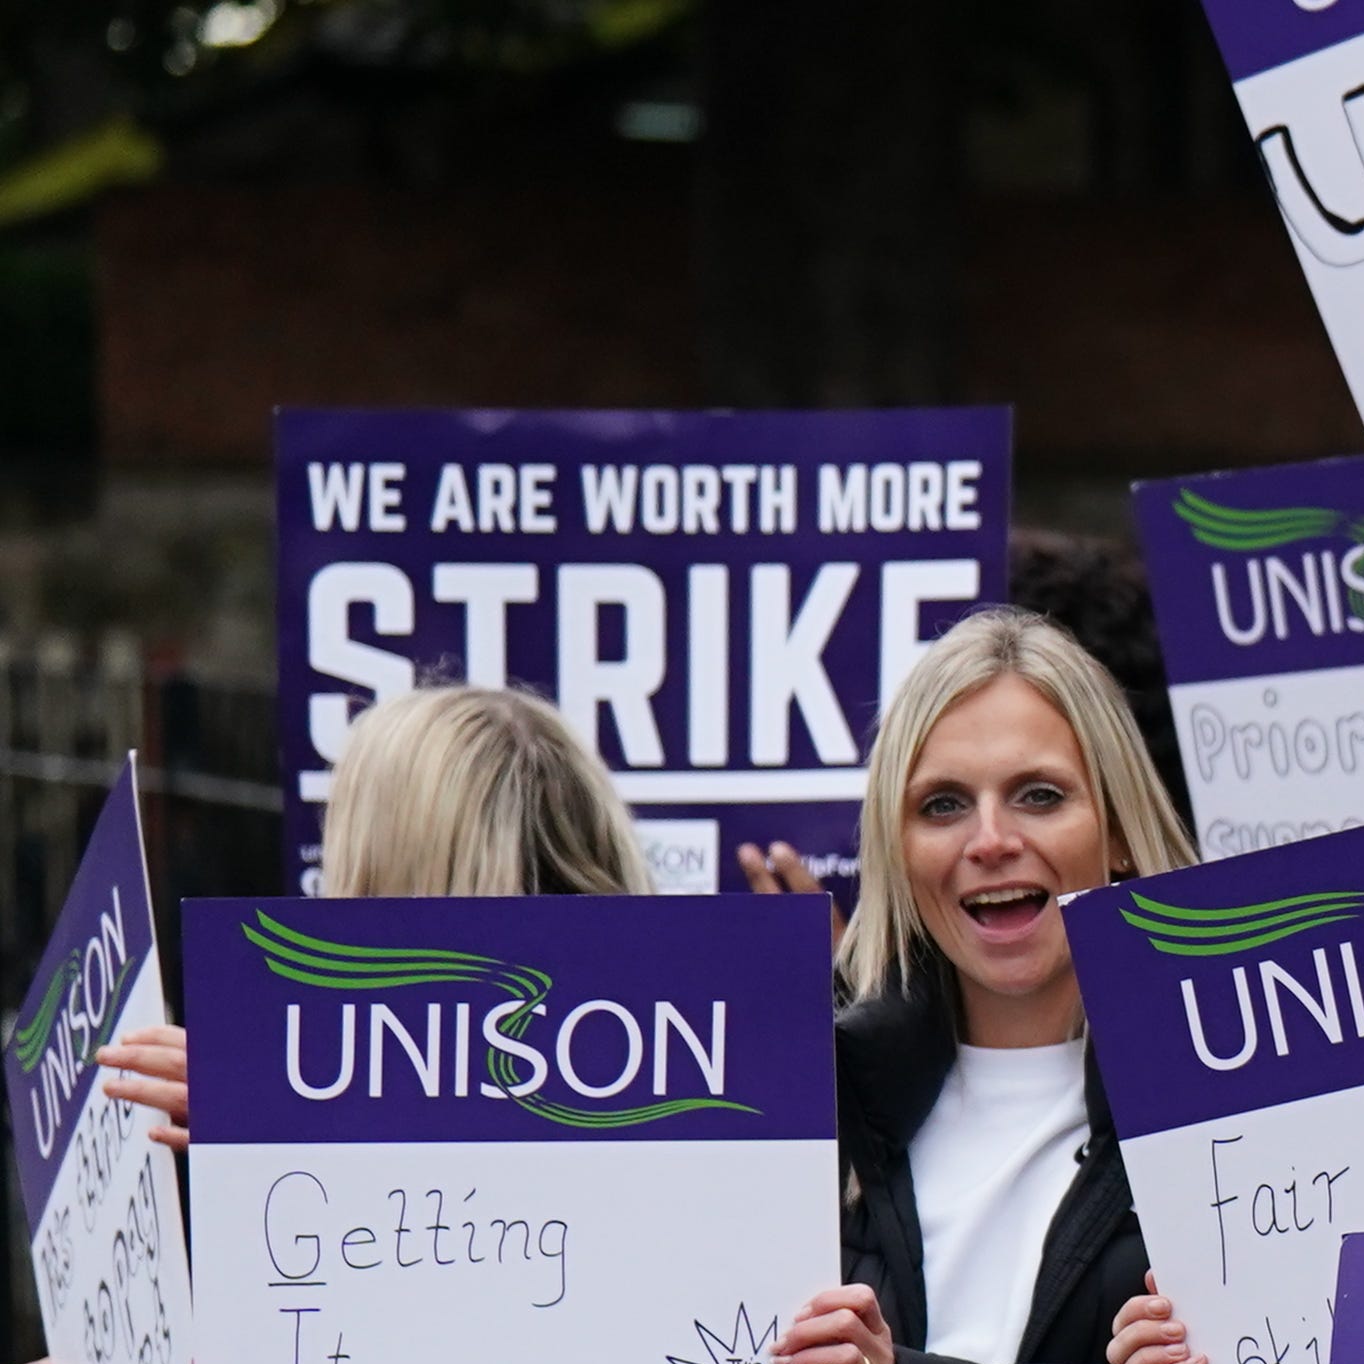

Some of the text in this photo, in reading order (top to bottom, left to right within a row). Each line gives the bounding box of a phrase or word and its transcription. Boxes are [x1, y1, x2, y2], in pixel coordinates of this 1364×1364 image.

[306, 460, 983, 535] WE ARE WORTH MORE
[30, 884, 127, 1161] UNISON
[285, 999, 727, 1101] UNISON
[264, 1170, 569, 1307] Getting
[1210, 1134, 1350, 1286] Fair
